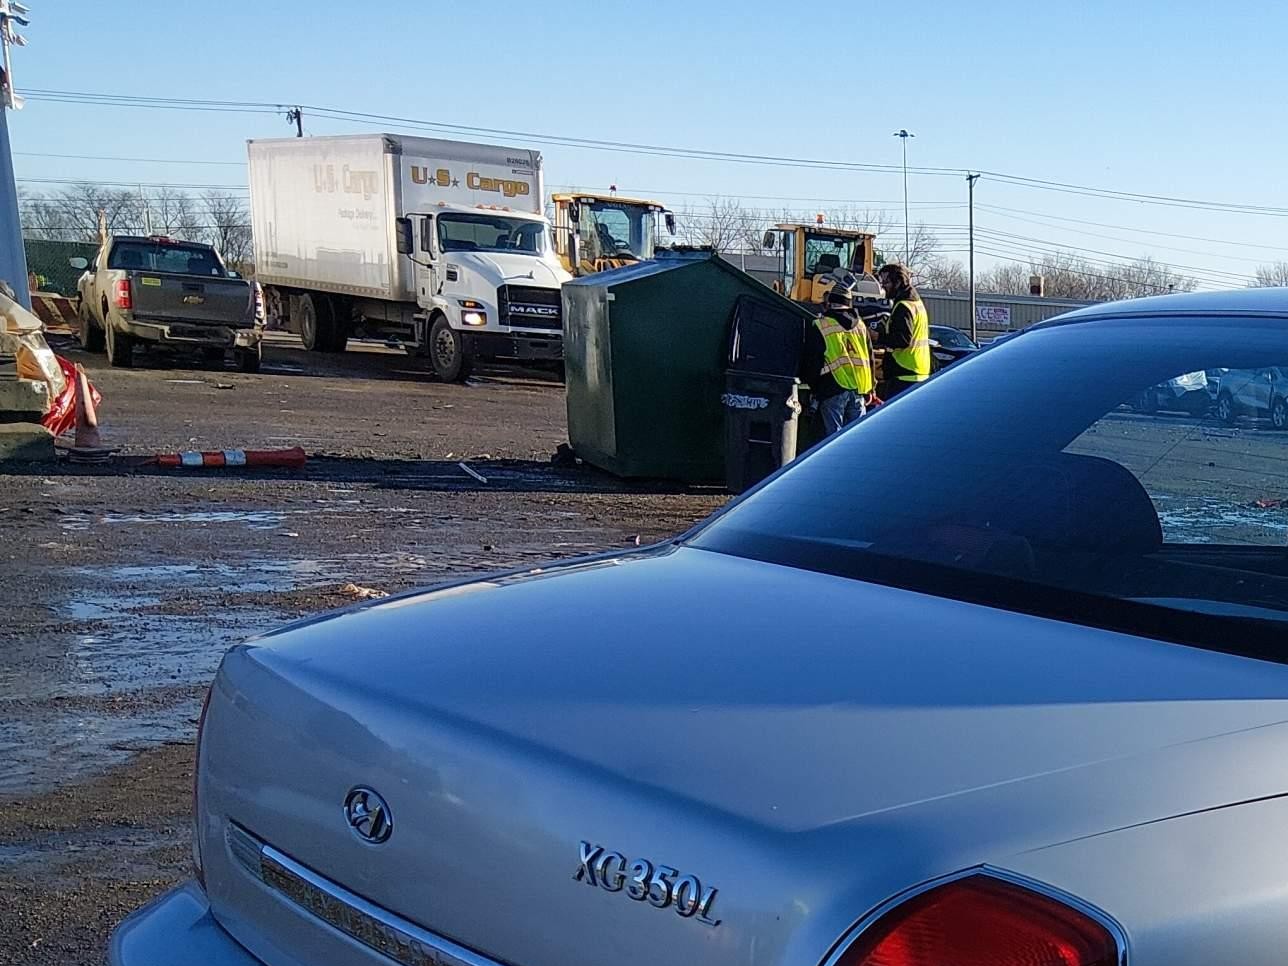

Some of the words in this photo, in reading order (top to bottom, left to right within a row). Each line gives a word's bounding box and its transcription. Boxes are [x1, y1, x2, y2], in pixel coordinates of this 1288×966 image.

[466, 172, 530, 198] Cargo
[510, 306, 560, 316] MACK
[572, 839, 723, 928] XG350L
